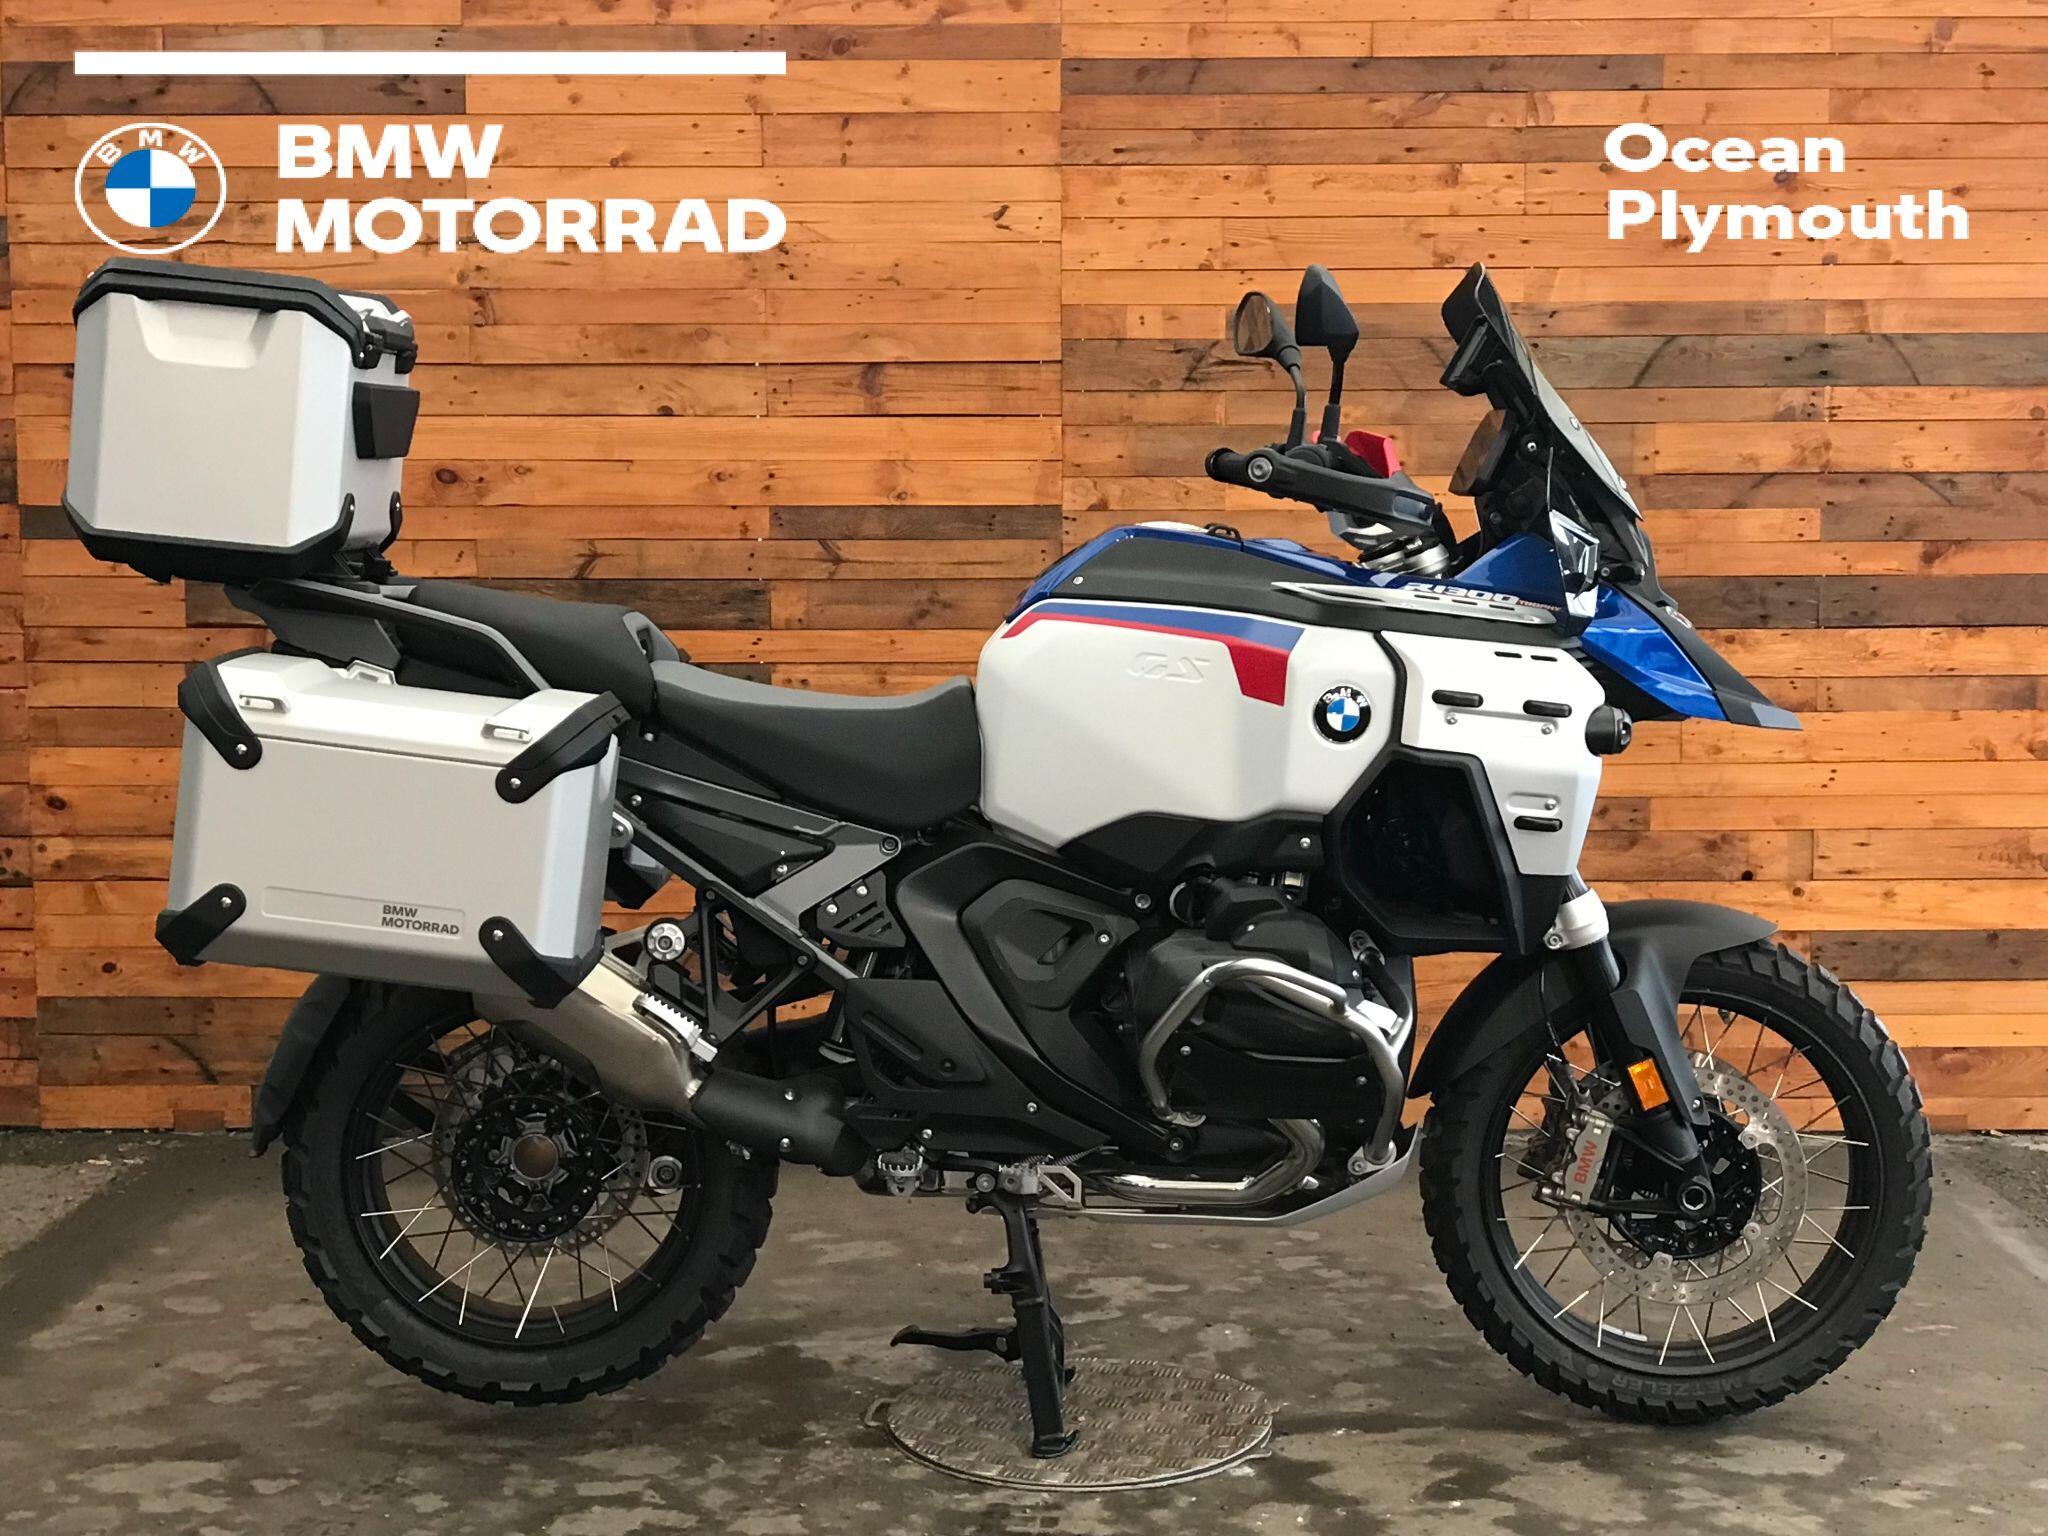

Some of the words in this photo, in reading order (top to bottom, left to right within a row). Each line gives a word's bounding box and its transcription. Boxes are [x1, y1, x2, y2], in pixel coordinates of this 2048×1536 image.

[382, 904, 418, 917] BMW
[381, 917, 460, 935] MOTORRAD
[1574, 1140, 1597, 1185] BMW
[1611, 1372, 1744, 1397] METZELER
